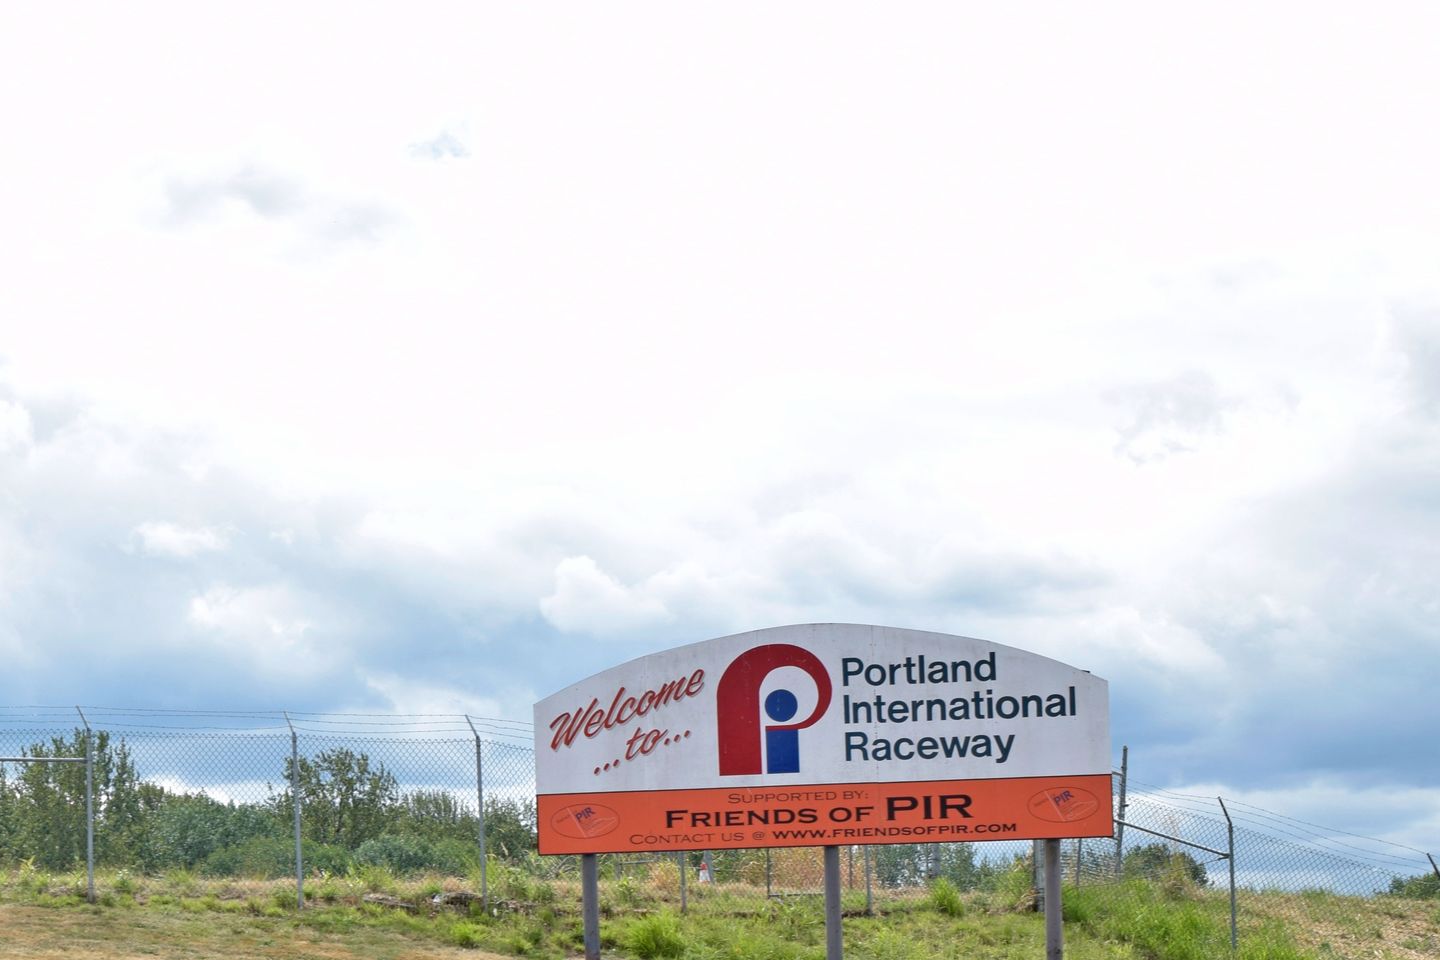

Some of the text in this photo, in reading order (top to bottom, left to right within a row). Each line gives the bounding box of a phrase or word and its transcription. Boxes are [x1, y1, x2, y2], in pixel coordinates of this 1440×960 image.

[842, 651, 997, 687] Portland
[549, 669, 705, 750] Welcome
[843, 686, 1077, 724] International
[845, 731, 1016, 764] Raceway
[665, 794, 974, 829] FRIENDS OF PIR
[727, 790, 869, 804] SUPPORTED BY:
[1054, 790, 1075, 806] PIR
[575, 807, 596, 822] PIR
[629, 832, 715, 845] CONTACT
[721, 831, 744, 842] US
[752, 831, 766, 841] @
